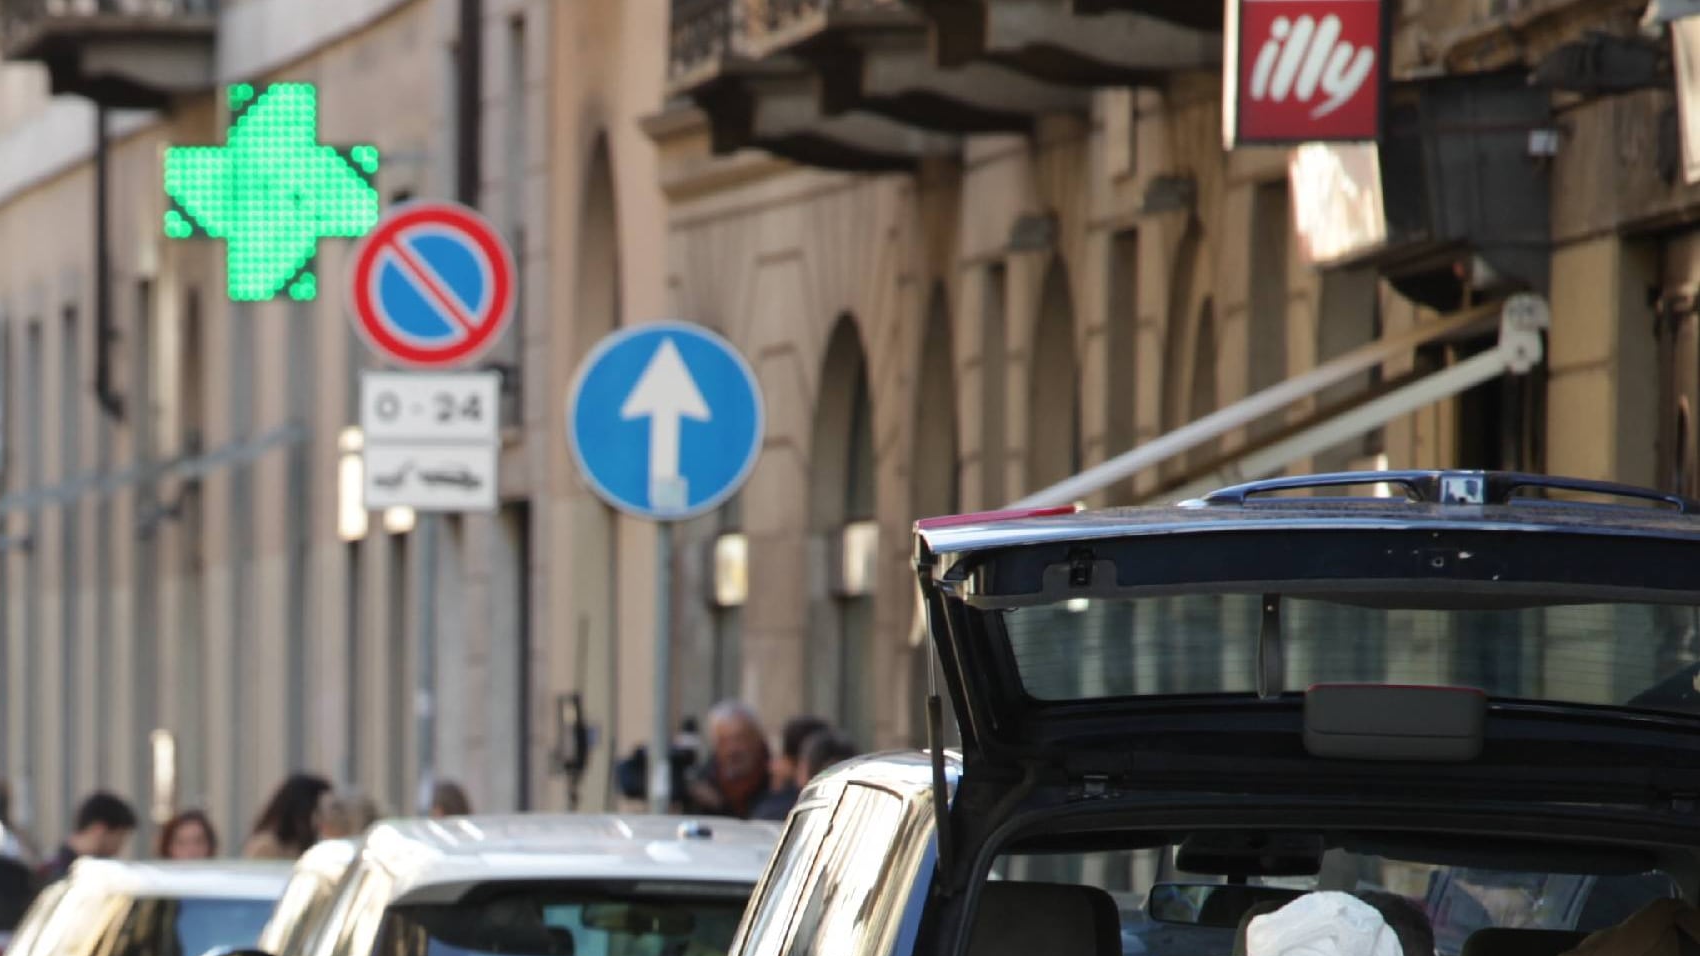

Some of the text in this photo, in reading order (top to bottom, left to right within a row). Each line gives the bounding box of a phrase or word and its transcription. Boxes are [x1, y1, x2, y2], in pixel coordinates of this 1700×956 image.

[1251, 14, 1375, 120] illy
[374, 390, 402, 425] 0
[434, 390, 483, 425] 24
